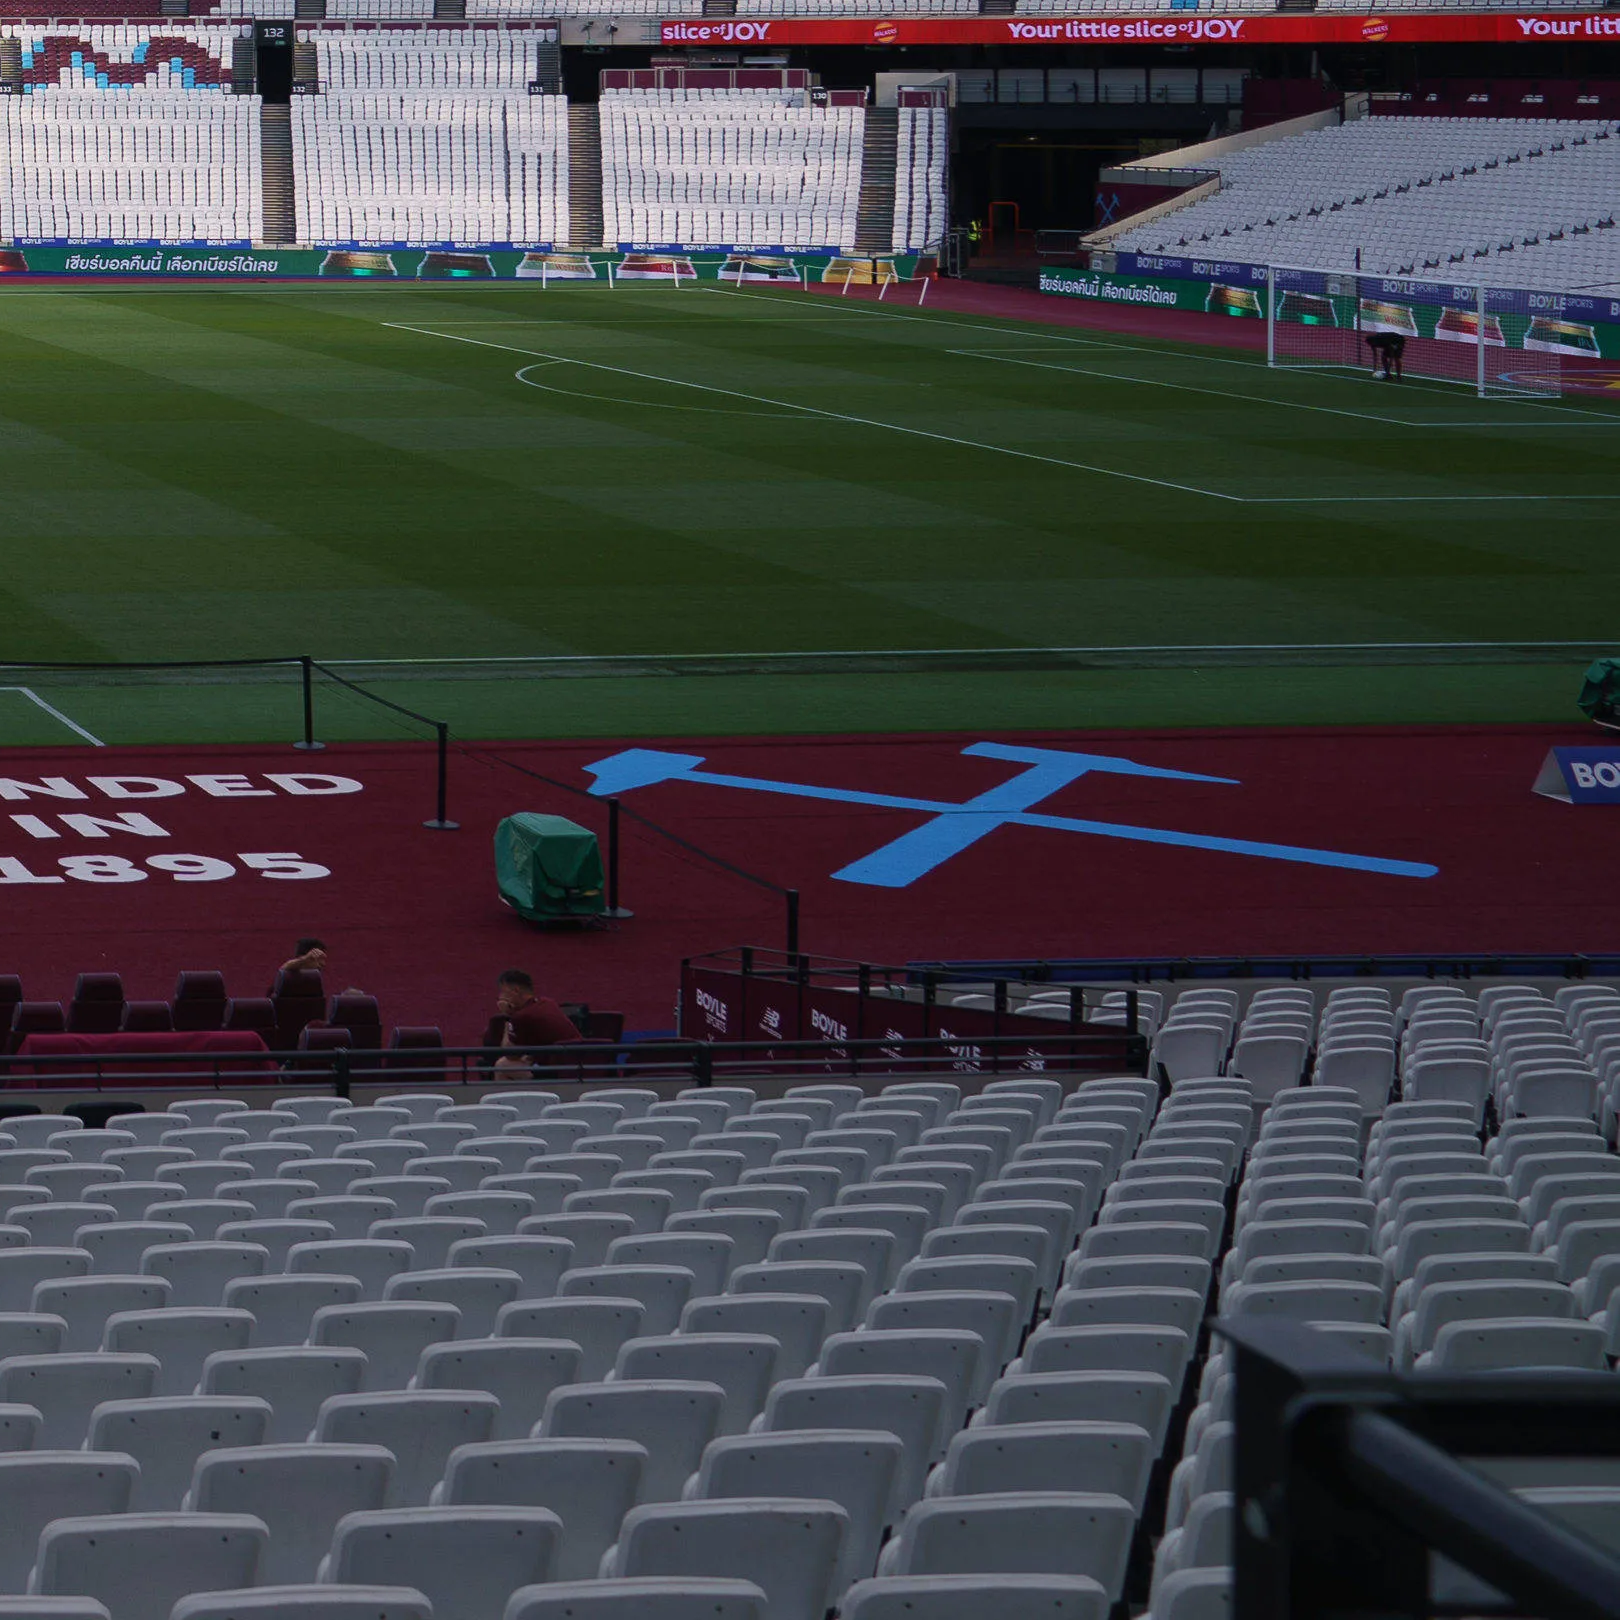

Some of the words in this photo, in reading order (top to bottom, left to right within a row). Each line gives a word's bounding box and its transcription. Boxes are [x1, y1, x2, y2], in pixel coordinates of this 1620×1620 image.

[264, 28, 284, 38] 132
[662, 23, 710, 40] slice
[712, 23, 727, 35] of
[723, 23, 770, 40] JOY
[1008, 22, 1062, 38] Your
[1065, 21, 1120, 38] little
[1123, 21, 1176, 38] slice
[1179, 22, 1195, 34] of
[1192, 20, 1245, 39] JOY
[1517, 18, 1582, 35] Your
[530, 85, 543, 93] 131
[813, 92, 827, 100] 130
[65, 251, 164, 270] เชียร์บอลคืนนี้
[166, 256, 278, 272] เลือกเบียร์ได้เลย
[1137, 256, 1164, 269] BOYLE
[1163, 258, 1182, 268] SPORTS
[1192, 262, 1220, 275] BOYLE
[1220, 264, 1240, 275] SPORTS
[1251, 267, 1280, 281] BOYE
[1382, 280, 1415, 295] BOYLE
[1453, 287, 1488, 303] BOYE
[1528, 294, 1567, 311] BOYLE
[1567, 297, 1594, 309] SPORTS
[1569, 762, 1620, 788] BO
[9, 812, 171, 839] IN
[695, 988, 728, 1021] BOYLE
[811, 1008, 848, 1041] BOYLE
